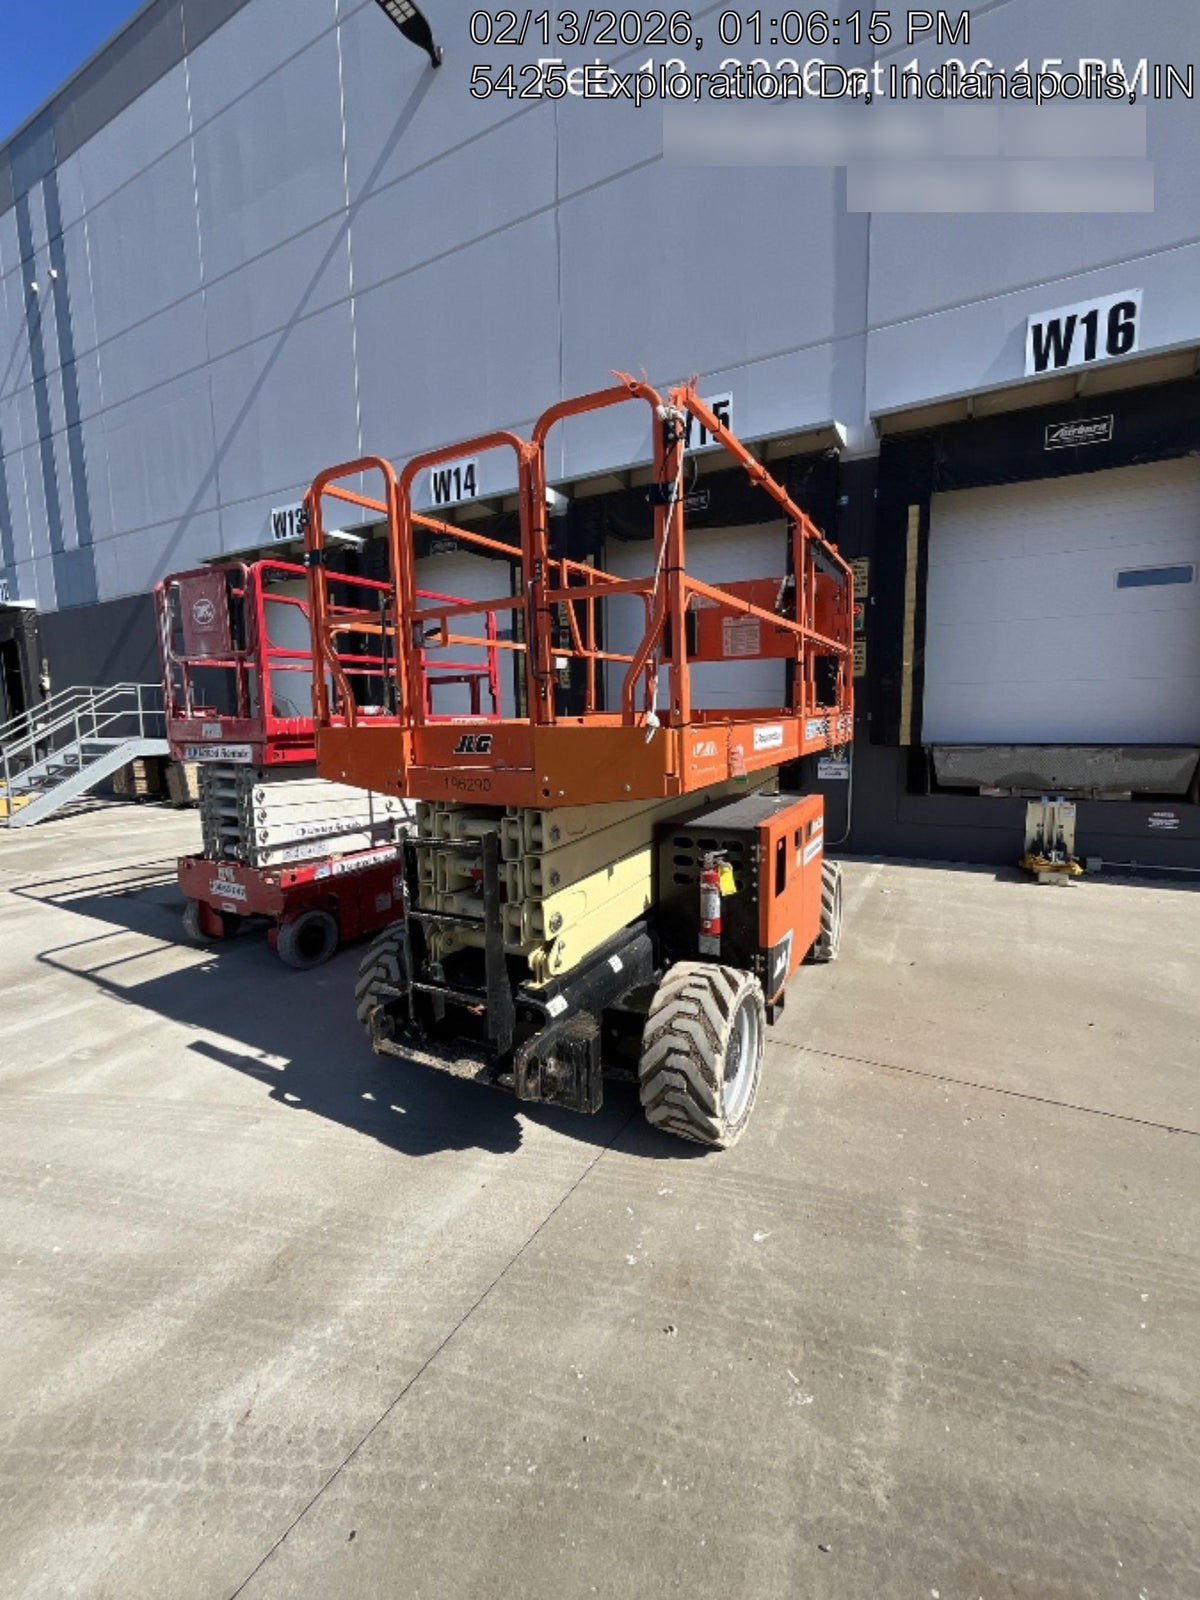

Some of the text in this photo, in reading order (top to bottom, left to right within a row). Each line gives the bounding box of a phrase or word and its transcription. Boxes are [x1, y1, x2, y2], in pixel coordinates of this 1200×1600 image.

[1032, 301, 1137, 372] W16
[433, 463, 476, 504] W14
[454, 733, 493, 754] JLG
